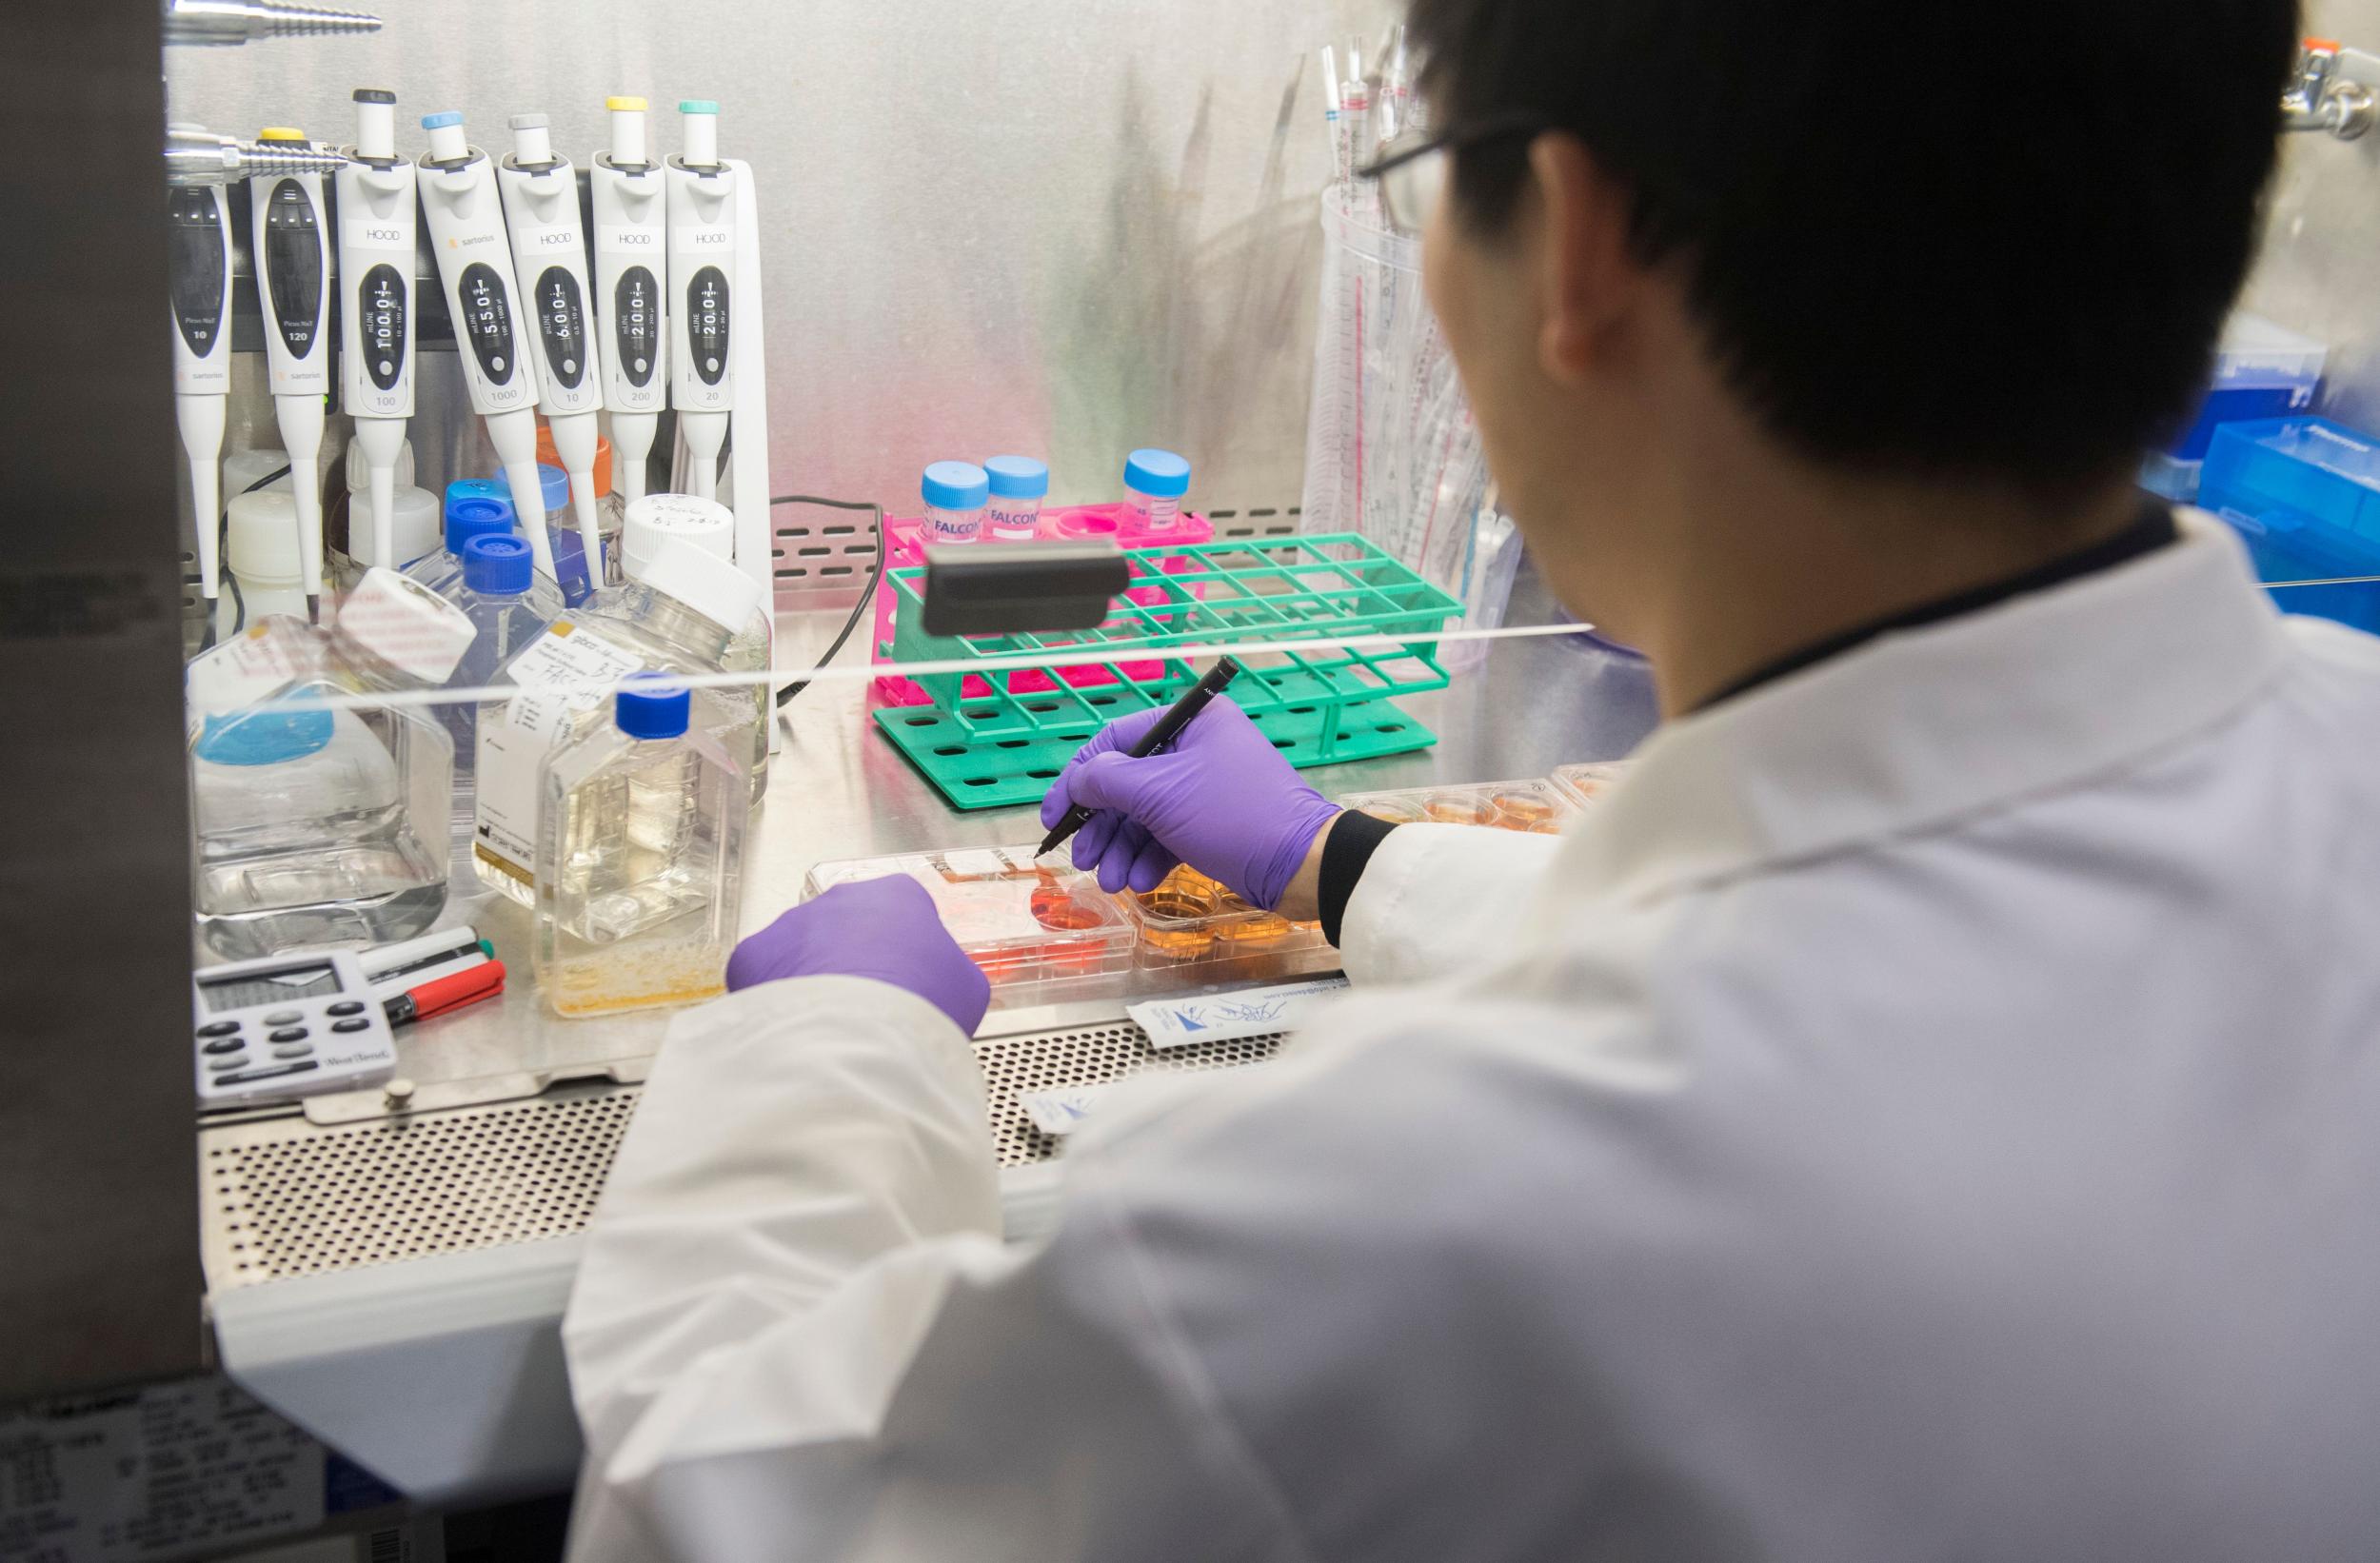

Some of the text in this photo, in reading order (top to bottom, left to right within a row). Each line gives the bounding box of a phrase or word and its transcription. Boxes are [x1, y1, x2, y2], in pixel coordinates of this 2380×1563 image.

[367, 229, 401, 241] HOOD
[462, 235, 495, 247] sartorius
[541, 232, 572, 245] HOOD
[619, 234, 651, 245] HOOD
[696, 233, 725, 245] HOOD
[477, 297, 499, 334] 550
[631, 299, 645, 336] 200
[193, 330, 208, 340] 10
[288, 332, 307, 341] 120
[376, 397, 396, 406] 100
[491, 389, 518, 402] 1000
[566, 393, 579, 403] 10
[631, 392, 650, 402] 200
[706, 392, 719, 401] 20
[991, 509, 1036, 525] FALCON
[935, 520, 979, 534] FALCON
